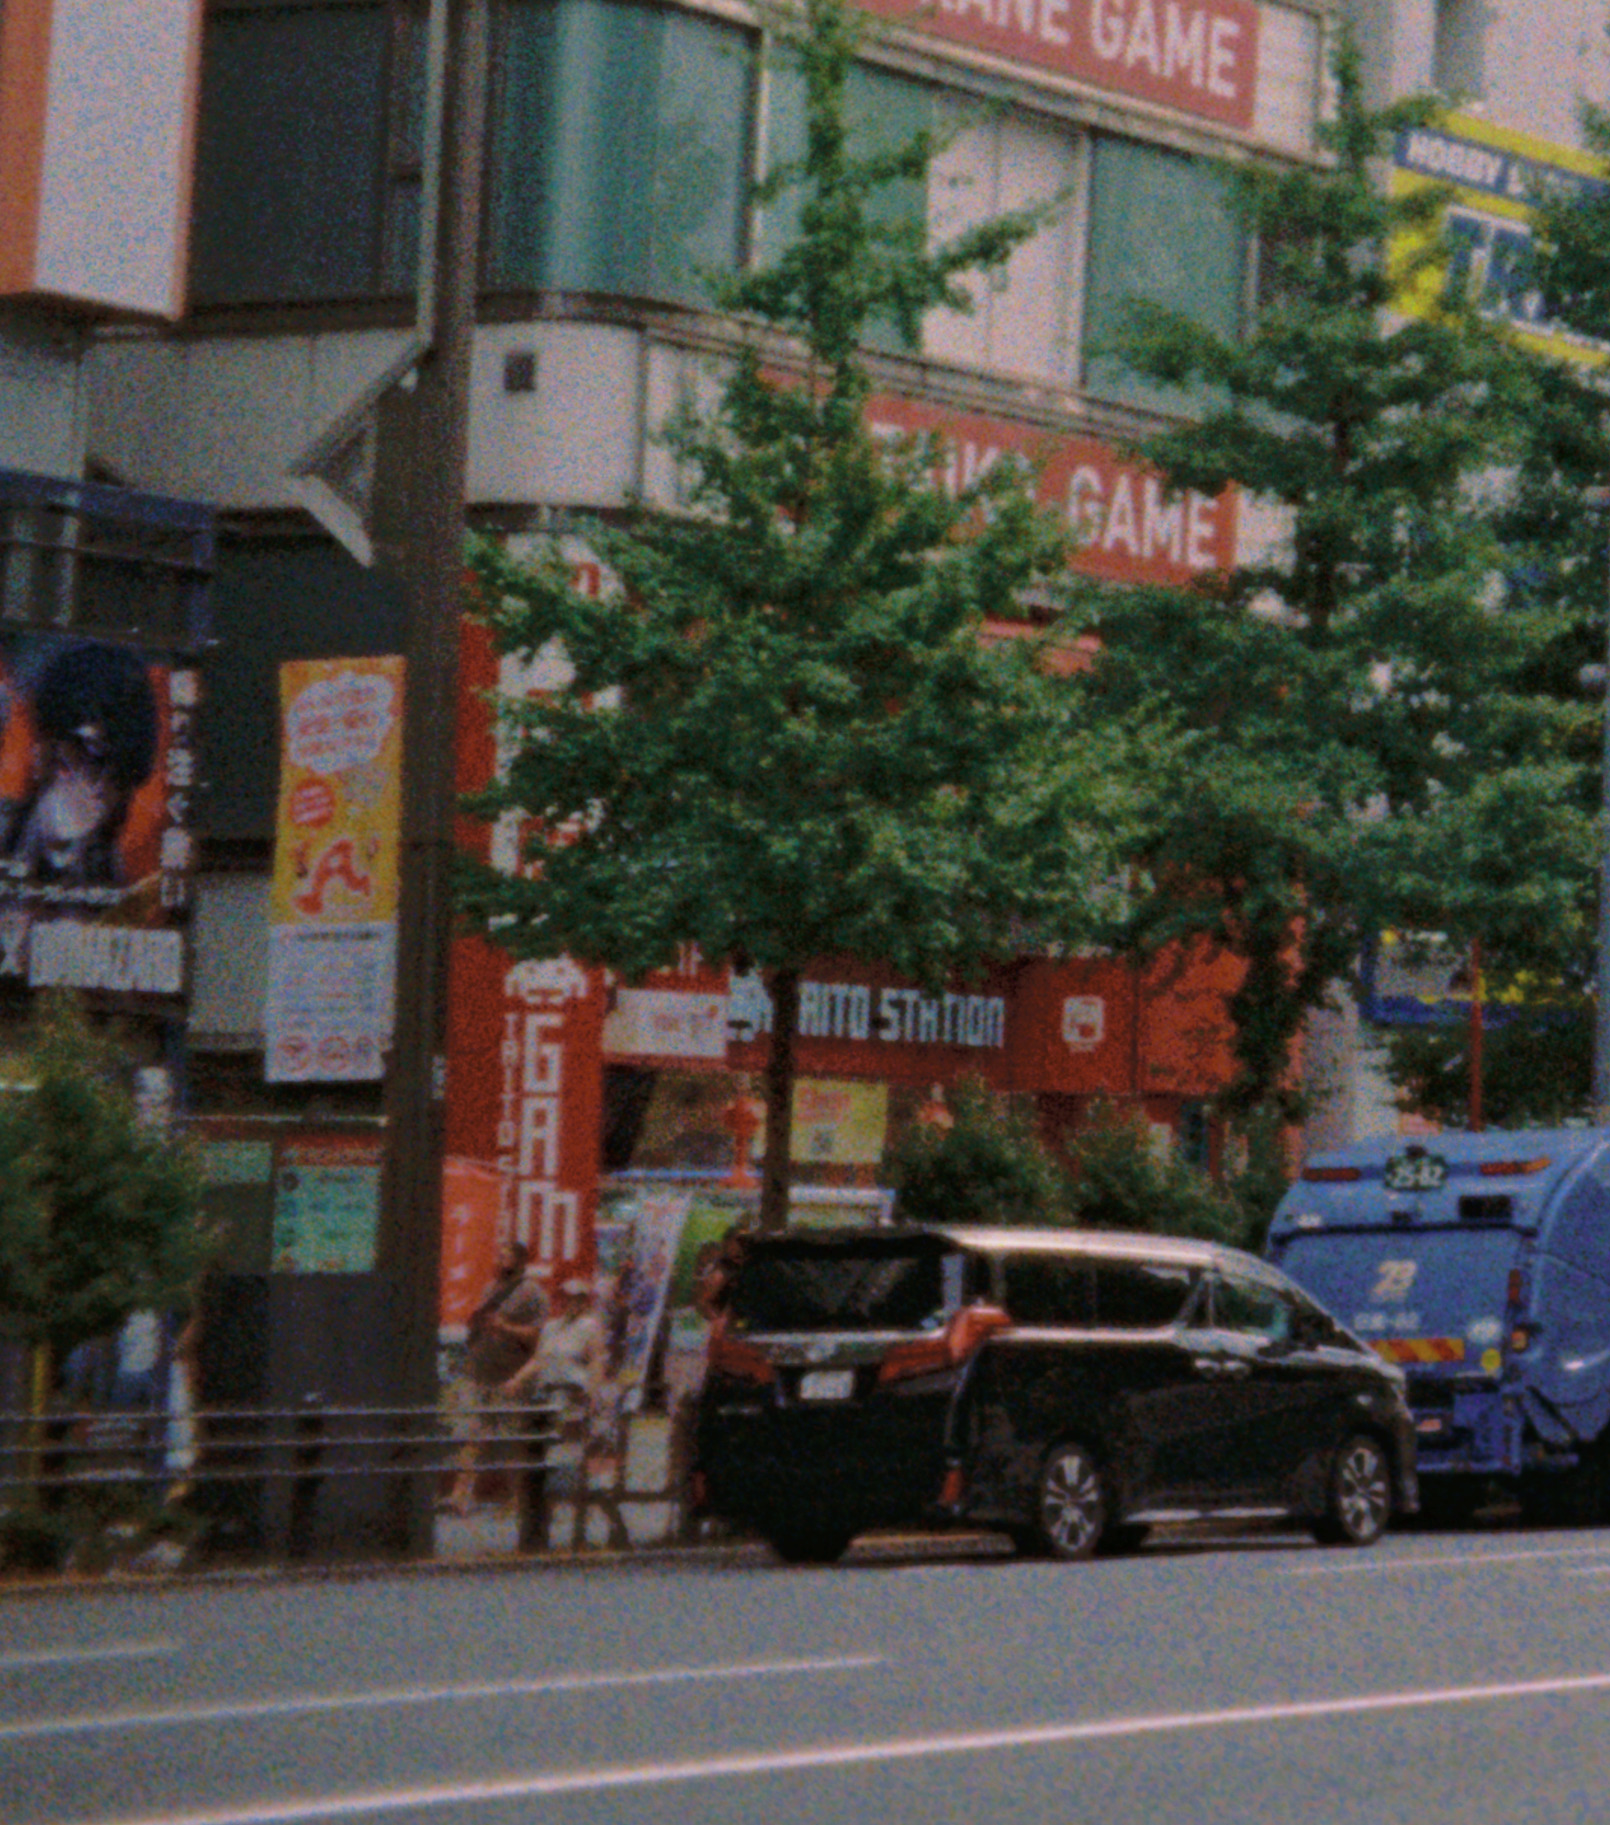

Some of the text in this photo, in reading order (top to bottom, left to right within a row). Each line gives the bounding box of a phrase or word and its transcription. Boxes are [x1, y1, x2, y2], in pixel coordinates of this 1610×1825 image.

[1068, 465, 1218, 568] GAME
[797, 980, 871, 1042] AITO
[516, 1012, 580, 1278] GAM
